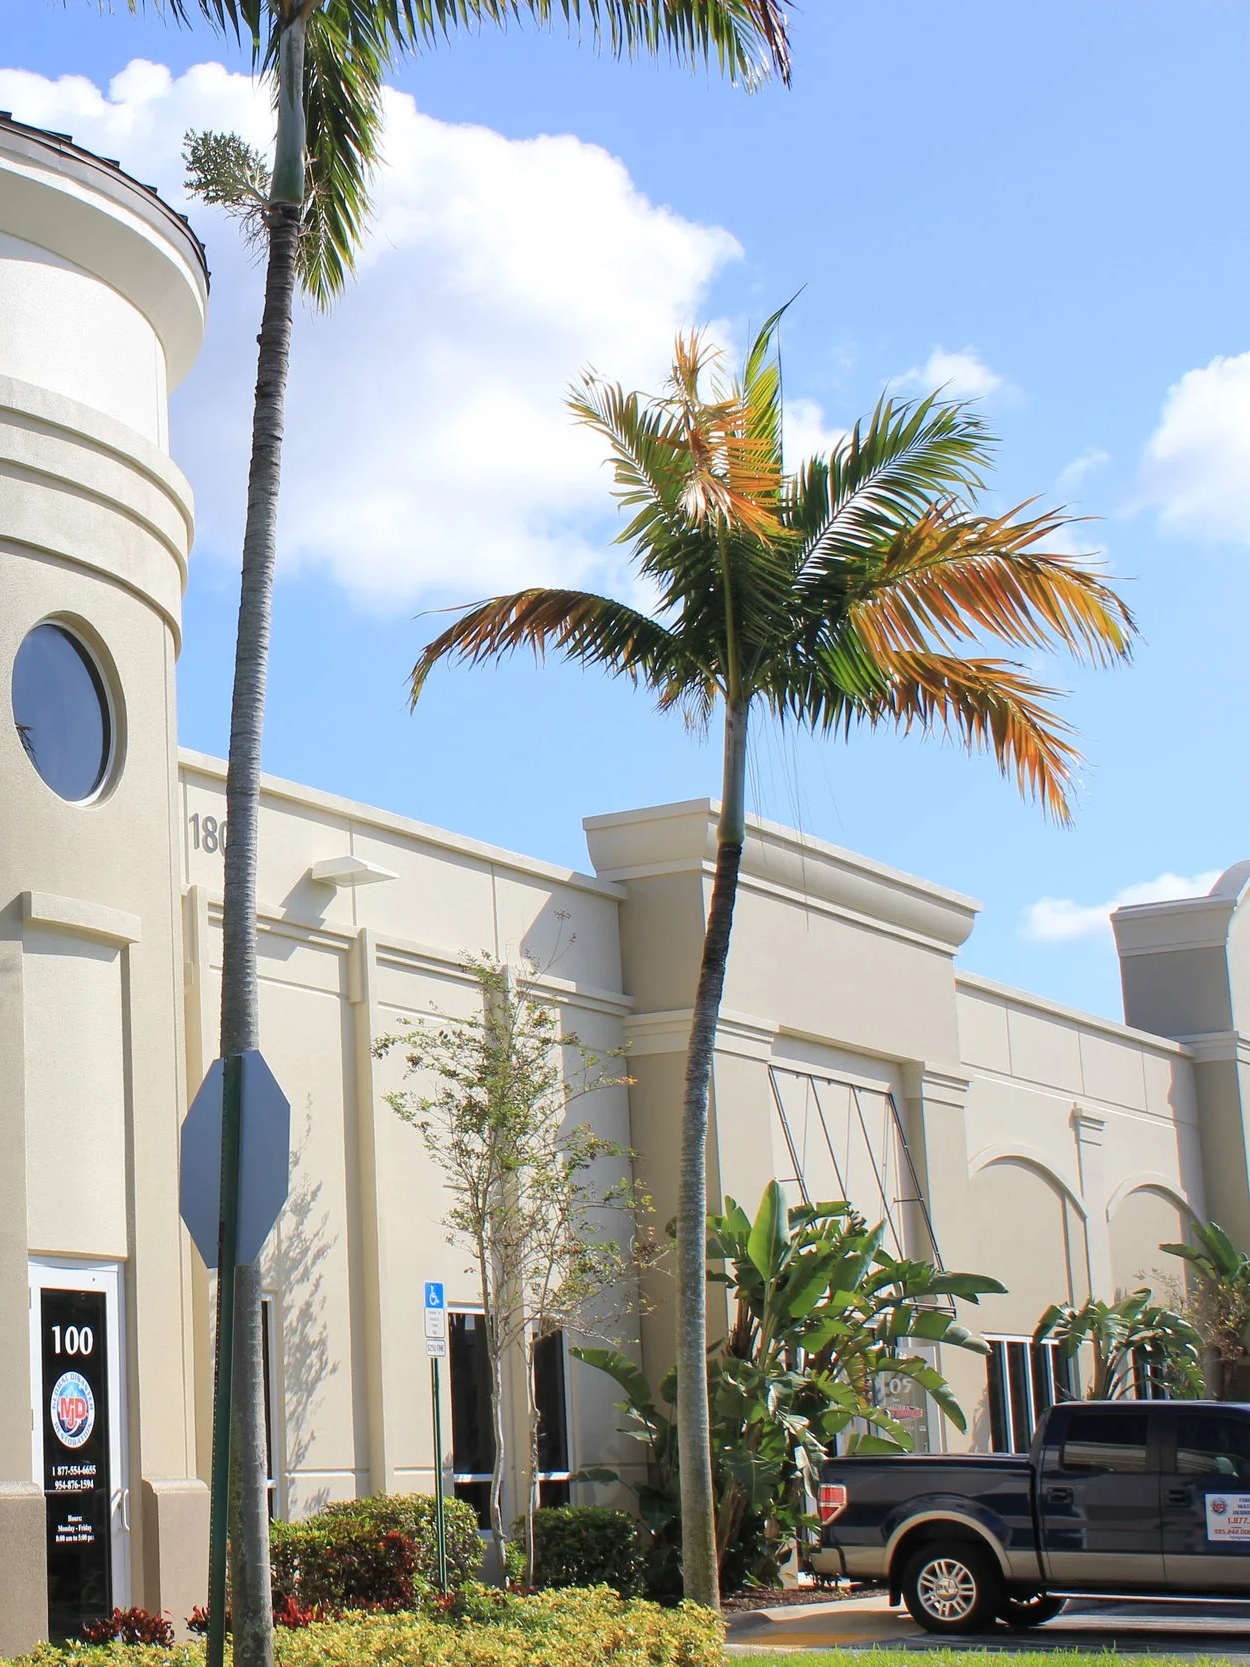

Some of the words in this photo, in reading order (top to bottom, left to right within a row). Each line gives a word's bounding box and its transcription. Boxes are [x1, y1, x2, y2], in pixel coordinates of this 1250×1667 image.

[52, 1326, 93, 1355] 100
[52, 1375, 70, 1410] GLOBAL
[70, 1374, 93, 1410] DISASTER
[54, 1421, 92, 1446] RESTORATION
[54, 1479, 94, 1490] 954-876-1594
[67, 1514, 83, 1522] Hours:
[58, 1525, 75, 1533] Monday
[78, 1524, 92, 1533] Friday
